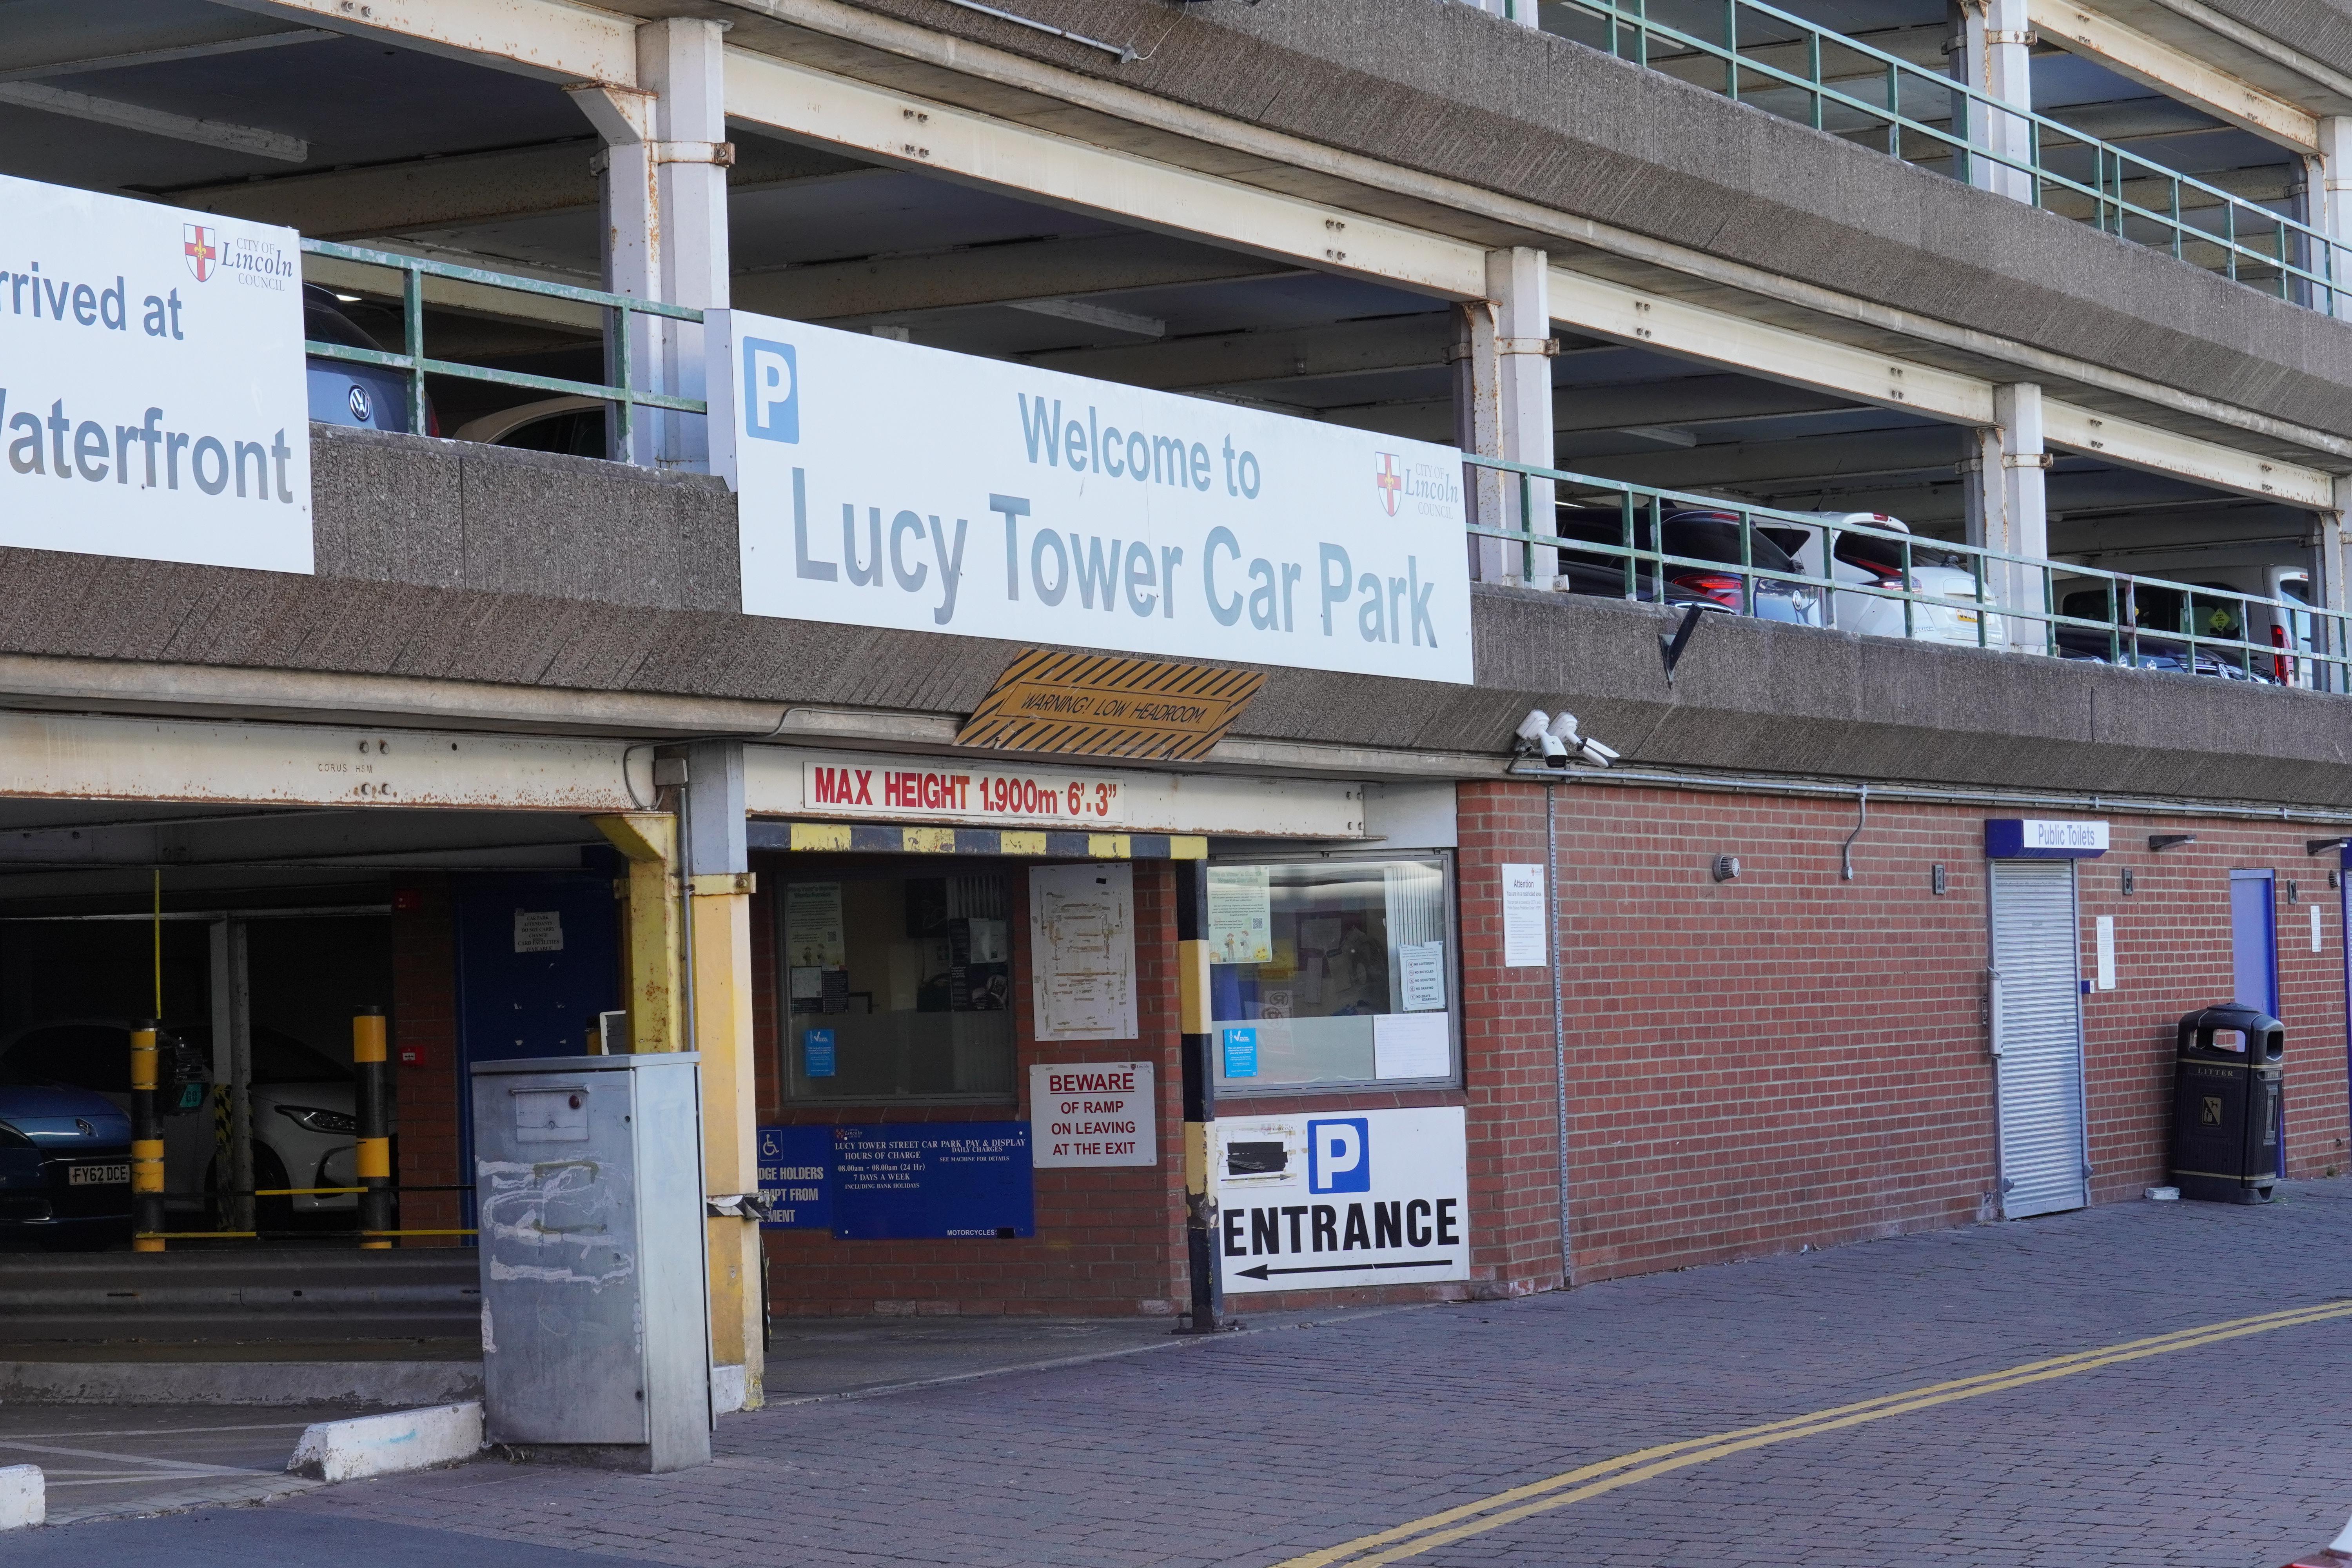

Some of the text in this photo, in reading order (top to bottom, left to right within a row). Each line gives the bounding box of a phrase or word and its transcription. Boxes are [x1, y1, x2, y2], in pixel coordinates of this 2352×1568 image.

[237, 238, 275, 254] CITY OF
[221, 242, 292, 277] Lincoln
[238, 273, 285, 291] COUNCIL
[143, 287, 184, 340] at
[0, 388, 294, 504] aterfront
[1018, 392, 1261, 499] Welcome to
[1416, 463, 1444, 479] CITY OF
[1405, 468, 1459, 504] Lincoln
[1418, 502, 1453, 519] COUNCIL
[792, 466, 1438, 648] Lucy Tower Car Park
[1021, 691, 1092, 714] WARNING!
[1094, 699, 1131, 717] LOW
[318, 764, 347, 772] CORUS
[815, 767, 873, 806] MAX
[885, 771, 970, 810] HEIGHT
[980, 777, 1058, 814] 1.900m
[2038, 824, 2095, 846] Public Toilets
[1514, 879, 1534, 888] Attention
[2198, 1068, 2233, 1077] LITTER
[1050, 1073, 1134, 1092] BEWARE
[1061, 1101, 1124, 1114] OF RAMP
[1051, 1121, 1136, 1135] ON LEAVING
[858, 1142, 887, 1150] TOWER
[889, 1141, 919, 1149] STREET
[992, 1138, 1026, 1147] DISPLAY
[1053, 1142, 1136, 1155] AT THE EXIT
[1316, 1123, 1361, 1189] P
[74, 1166, 127, 1182] FY62 DCE
[780, 1167, 824, 1180] HOLDERS
[900, 1163, 911, 1171] (24
[913, 1163, 926, 1171] Hr)
[790, 1188, 818, 1201] FROM
[1223, 1198, 1460, 1257] ENTRANCE
